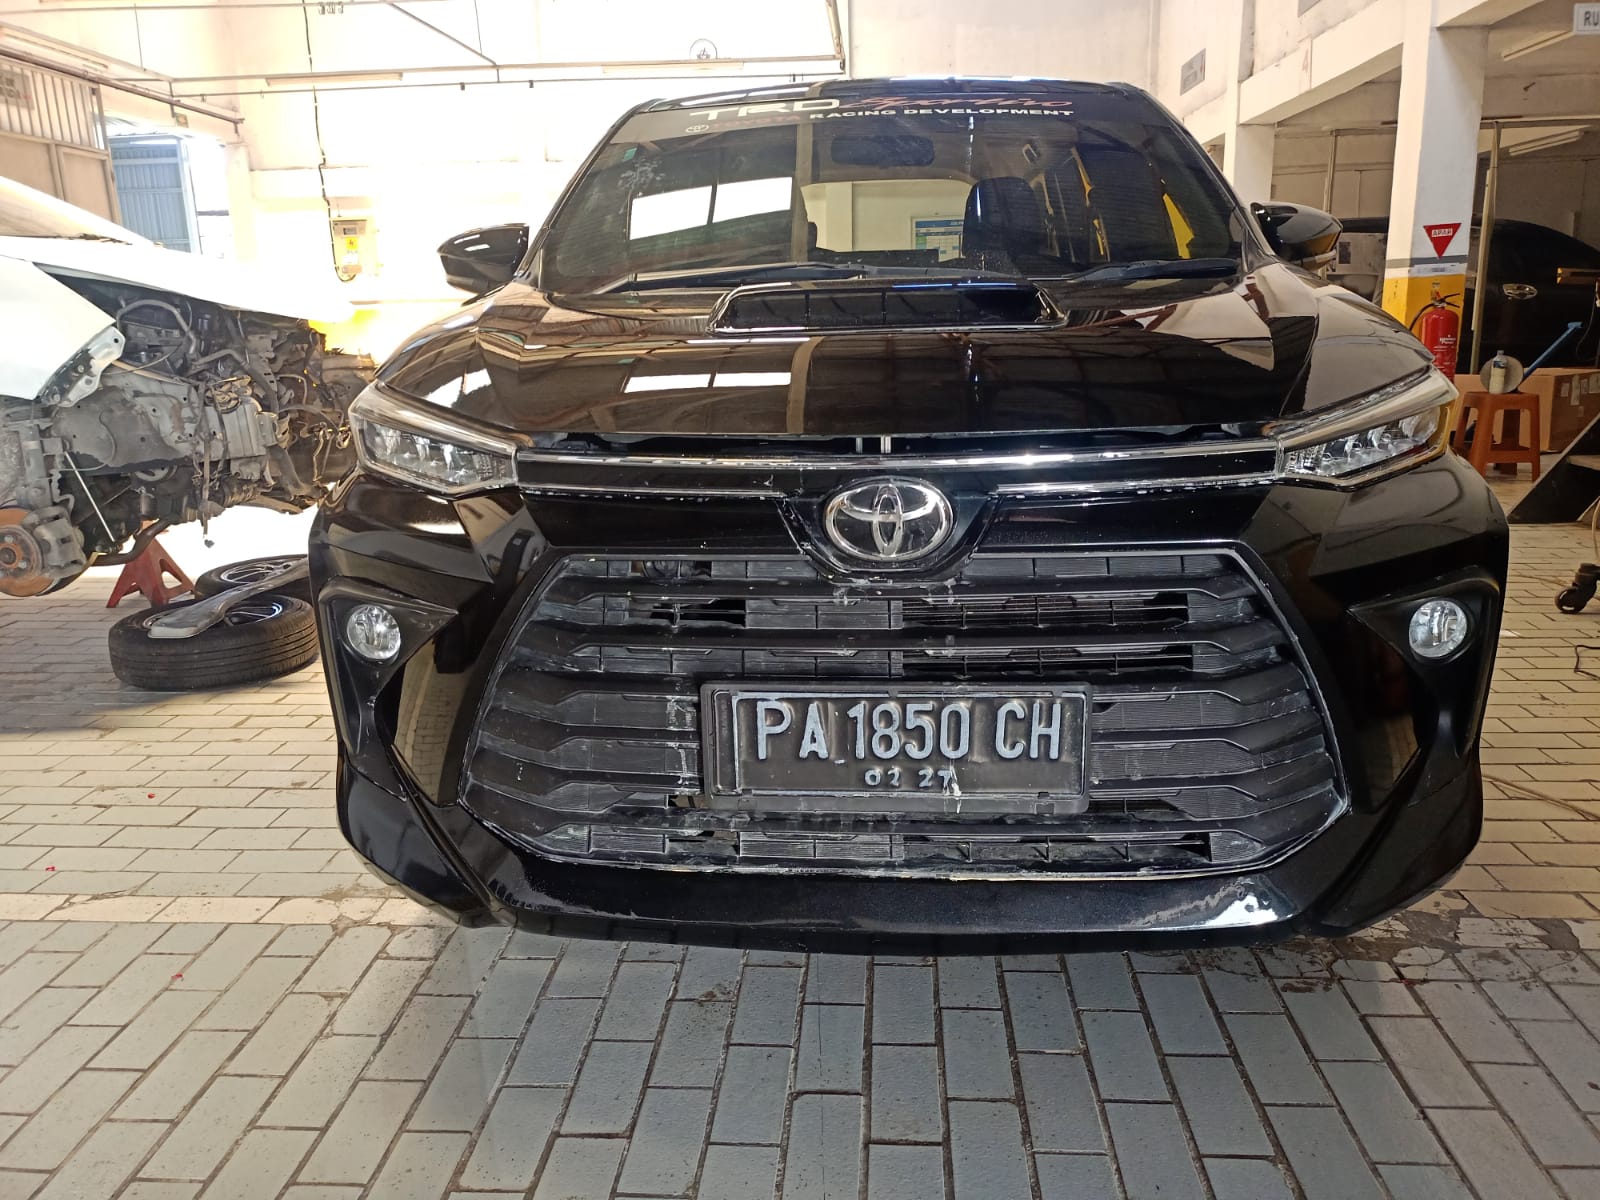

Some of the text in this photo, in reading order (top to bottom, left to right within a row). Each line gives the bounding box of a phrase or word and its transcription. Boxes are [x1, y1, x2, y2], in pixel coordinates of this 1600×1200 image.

[689, 99, 840, 121] TRD
[809, 108, 1074, 119] RACING DEVELOPMENT
[756, 700, 829, 760] PA
[846, 702, 970, 760] 1850
[995, 701, 1062, 760] CH
